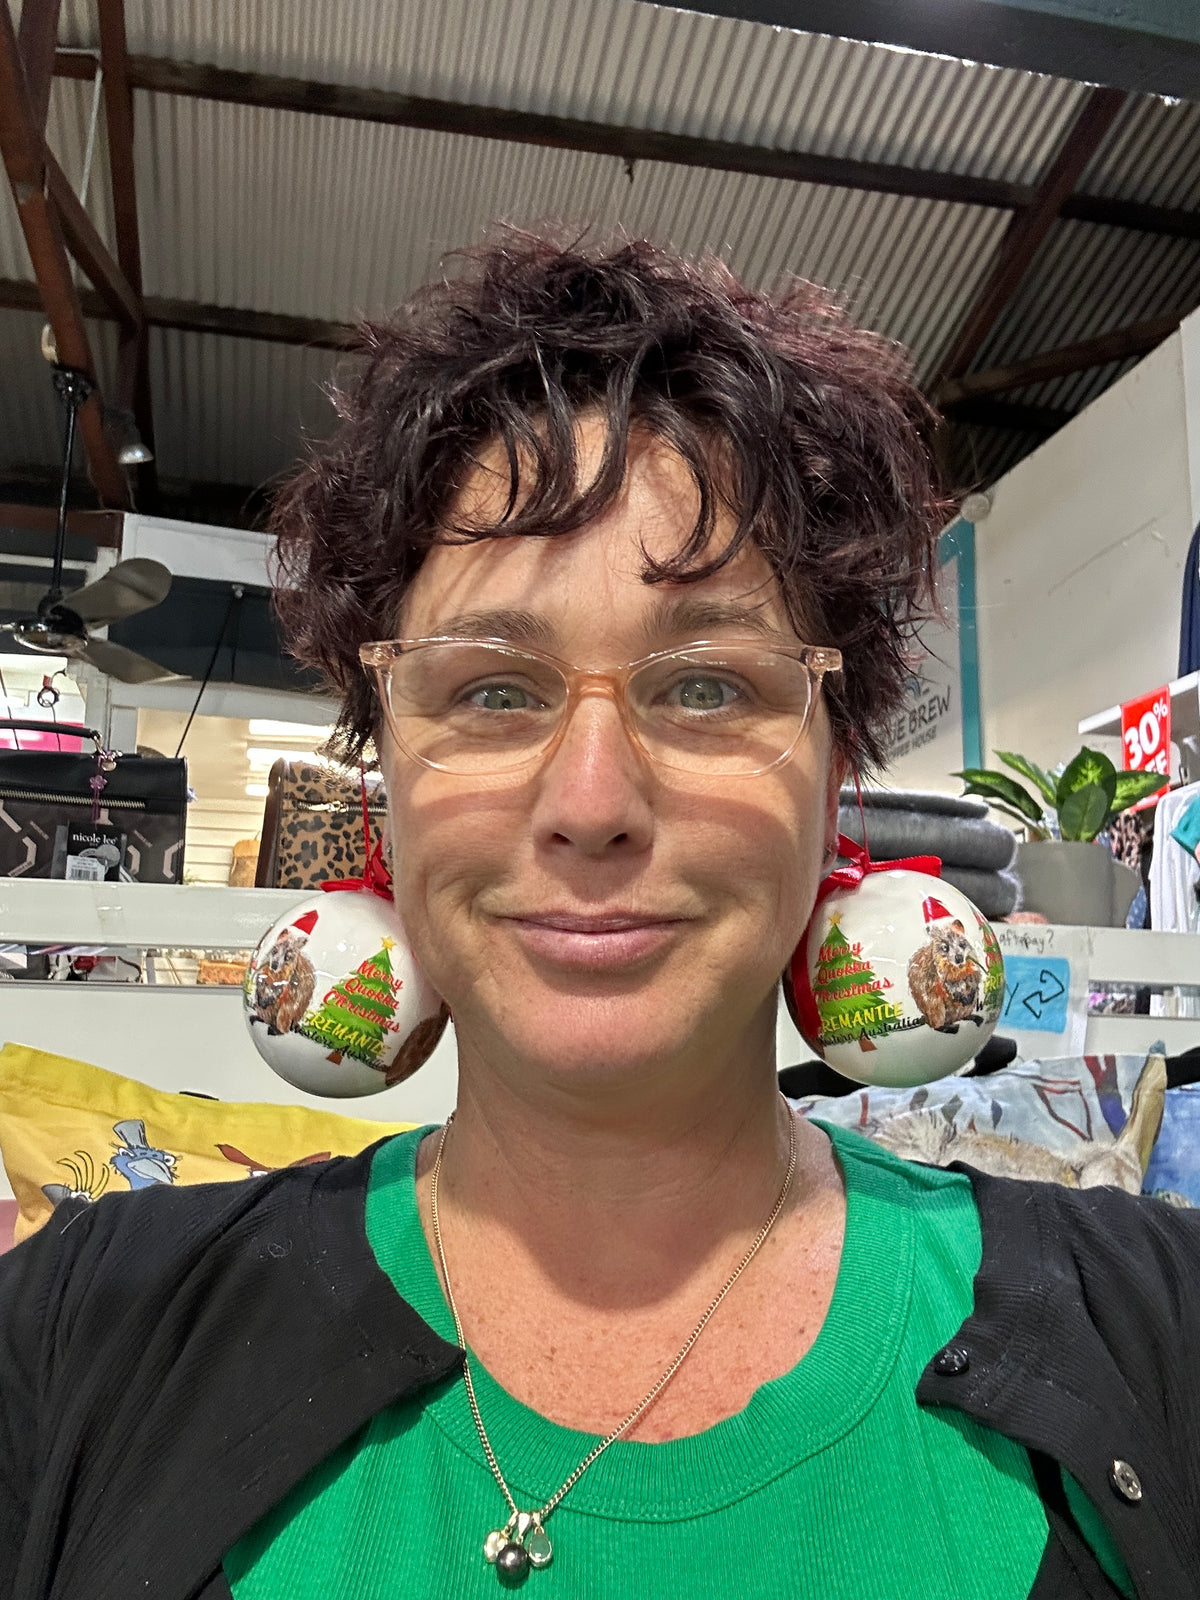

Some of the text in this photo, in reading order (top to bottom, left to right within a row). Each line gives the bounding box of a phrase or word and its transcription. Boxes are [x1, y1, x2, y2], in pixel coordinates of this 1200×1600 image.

[908, 684, 951, 734] BREW
[1124, 697, 1168, 770] 30%
[73, 832, 117, 845] nicole lee
[819, 942, 864, 961] Merry
[357, 960, 403, 990] Merry
[817, 961, 874, 985] Quokka
[344, 977, 400, 1010] Quokka
[323, 988, 400, 1033] Christmas
[821, 1002, 904, 1033] REMANTLE
[859, 1016, 926, 1040] Australia
